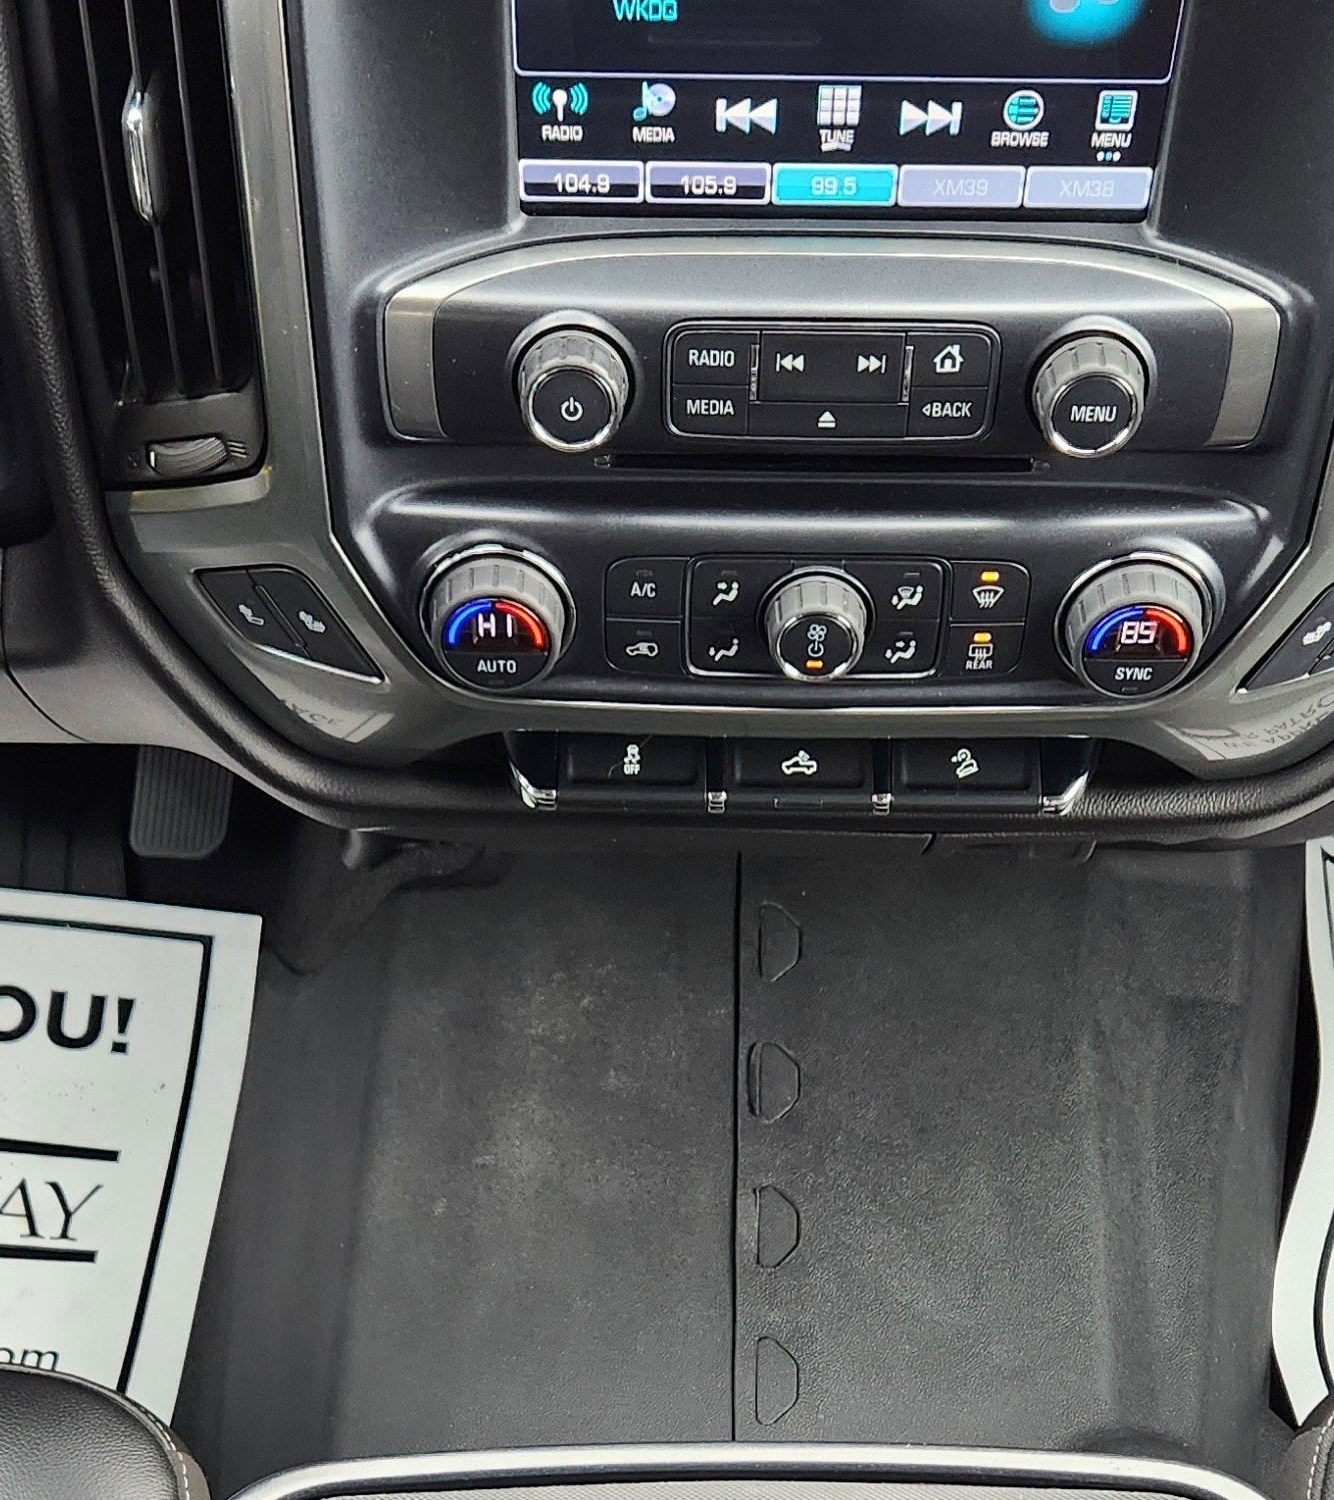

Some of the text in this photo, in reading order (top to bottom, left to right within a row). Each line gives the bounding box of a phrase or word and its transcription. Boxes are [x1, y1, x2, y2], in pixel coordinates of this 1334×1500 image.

[541, 125, 583, 141] RADIO
[632, 127, 675, 142] MEDIA
[820, 129, 854, 144] TUNE
[991, 131, 1049, 147] BROWSE
[1091, 132, 1132, 148] MENU
[553, 173, 610, 193] 104.9
[680, 175, 737, 195] 105.9
[811, 176, 857, 196] 99.5
[932, 178, 989, 197] XM39
[1059, 180, 1115, 198] XM38
[688, 349, 735, 368] RADIO
[686, 399, 735, 416] MEDIA
[931, 401, 972, 418] BACK
[1070, 405, 1117, 422] MENU
[630, 582, 656, 598] A/C
[478, 613, 514, 638] HI
[477, 659, 517, 673] AUTO
[966, 659, 993, 670] REAR
[1115, 667, 1153, 681] SYNC
[623, 763, 641, 775] OFF
